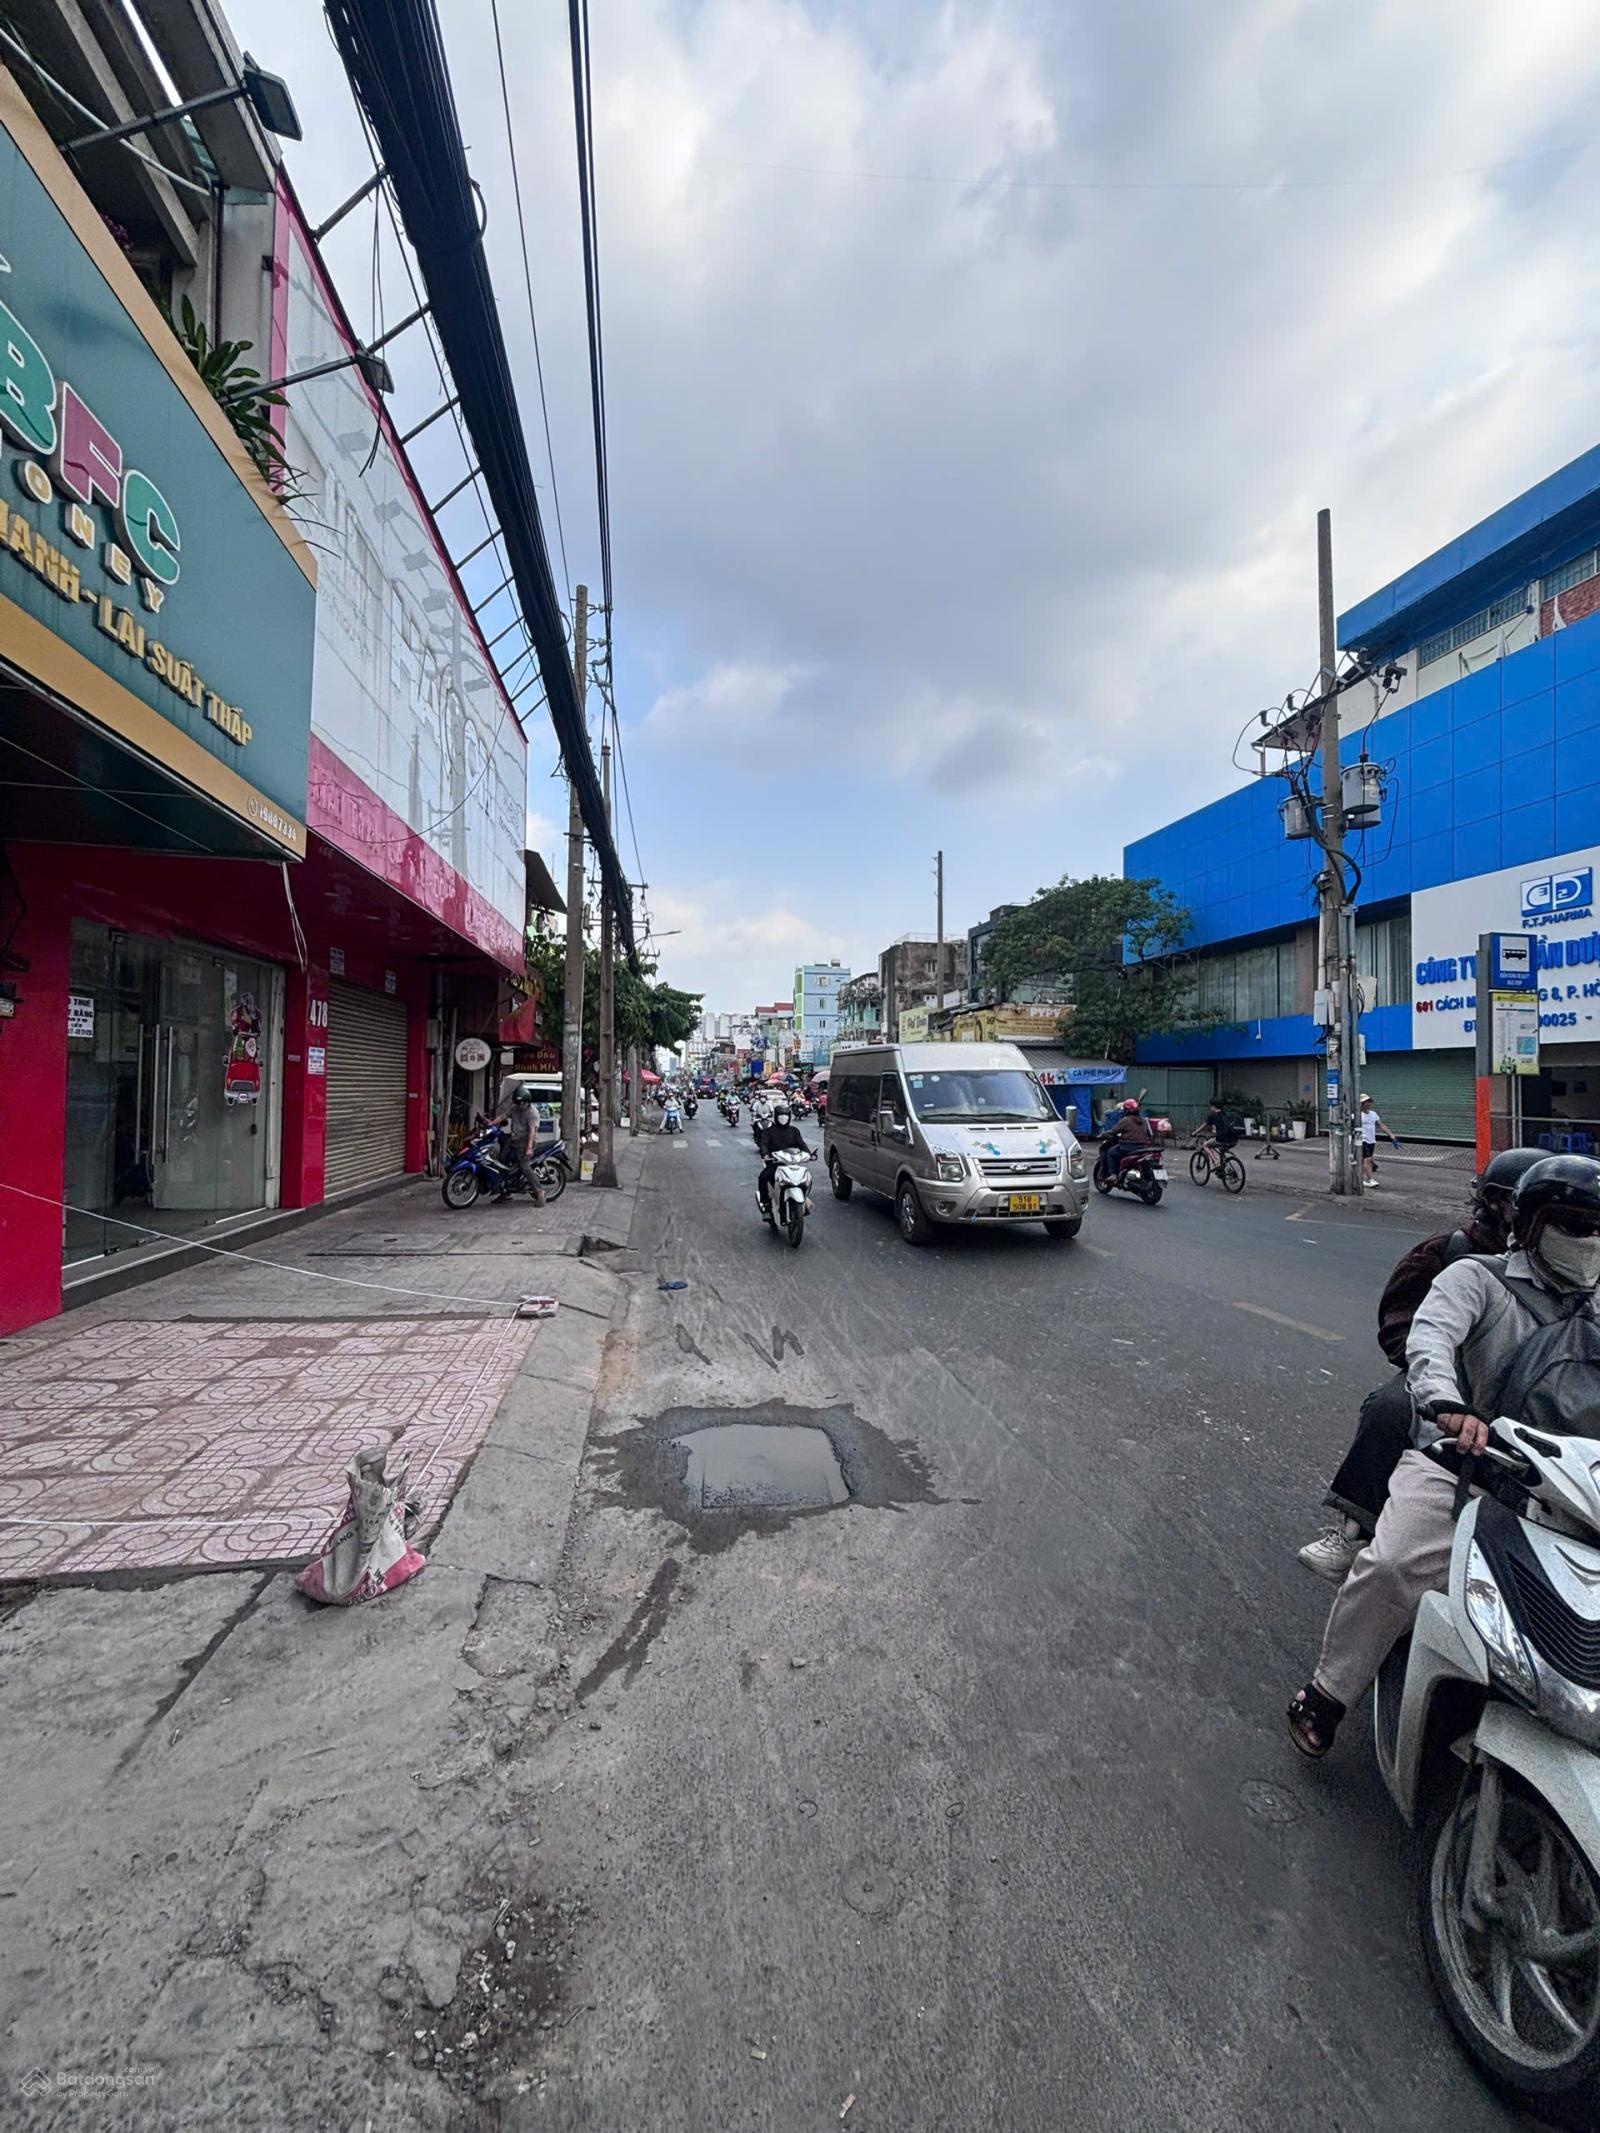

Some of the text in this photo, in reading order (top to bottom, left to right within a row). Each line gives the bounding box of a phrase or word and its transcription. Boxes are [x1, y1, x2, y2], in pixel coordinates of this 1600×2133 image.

[0, 428, 165, 614] ONEY
[1416, 956, 1457, 985] CÔNG
[1537, 934, 1563, 969] ẦN
[309, 999, 328, 1028] 478
[1416, 1000, 1433, 1013] 601
[1436, 995, 1464, 1011] CÁCH
